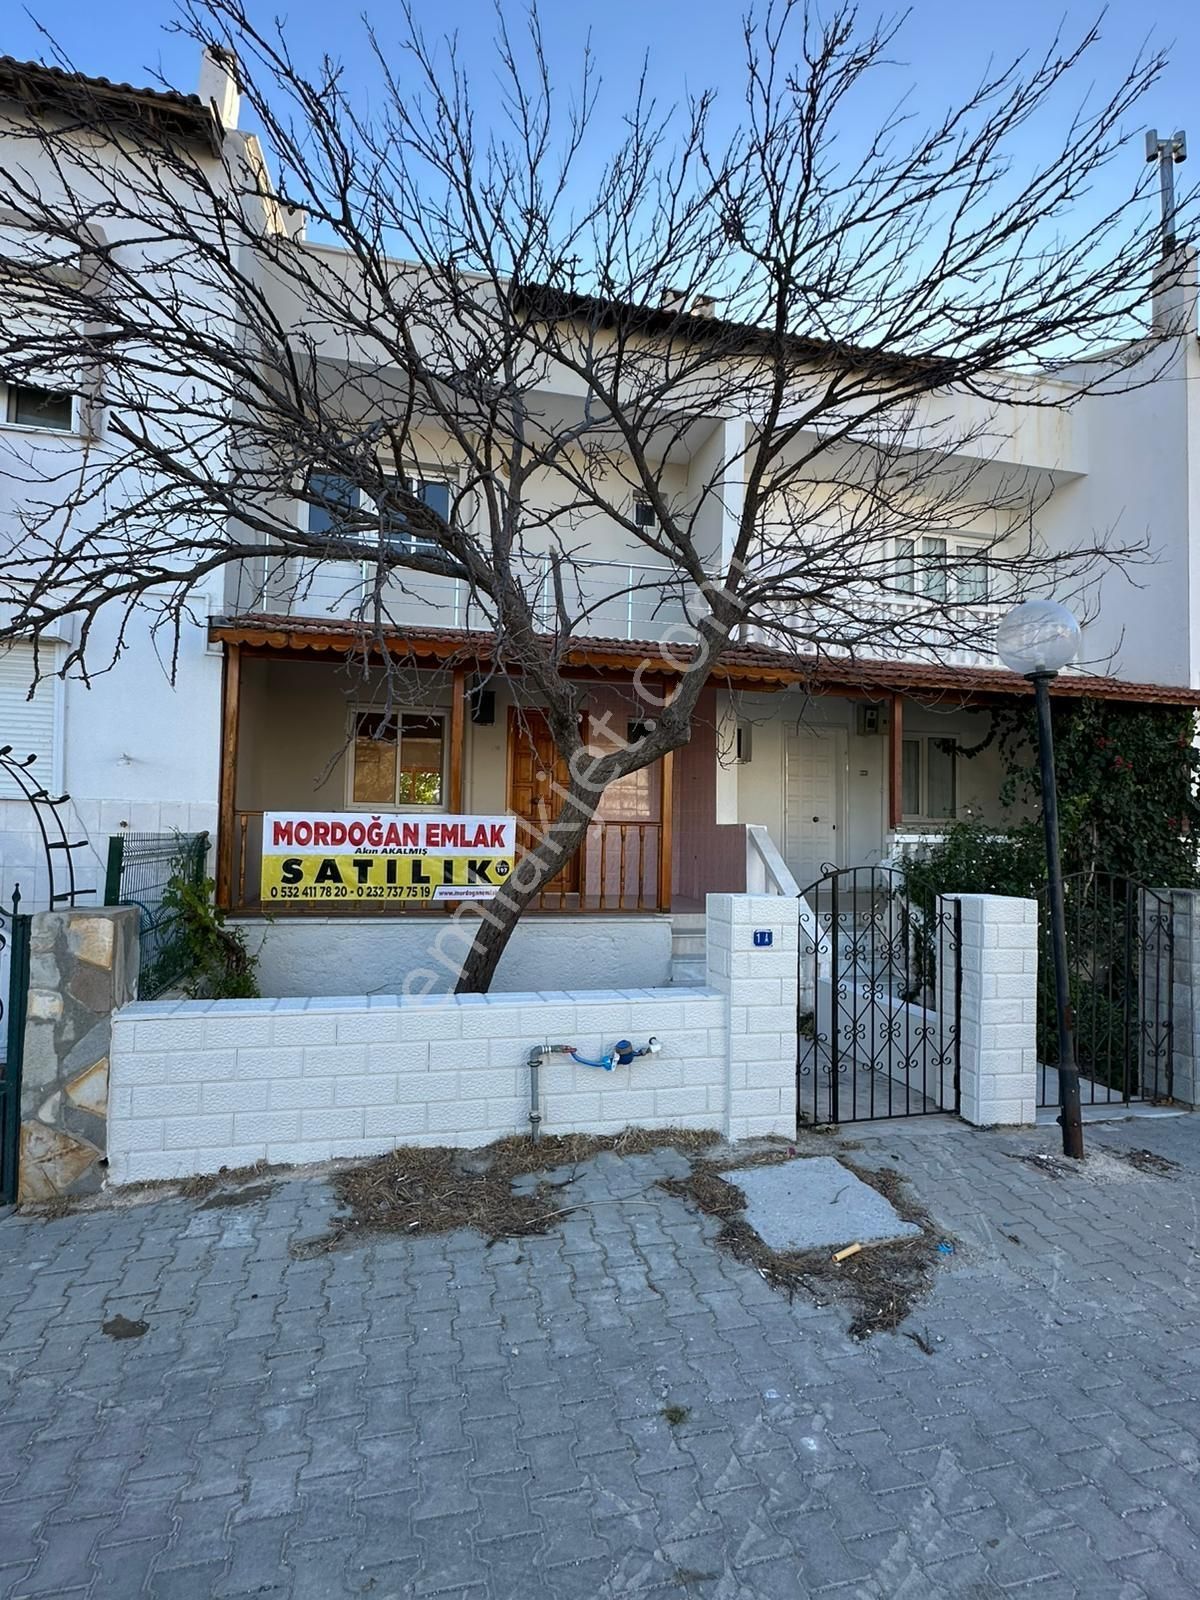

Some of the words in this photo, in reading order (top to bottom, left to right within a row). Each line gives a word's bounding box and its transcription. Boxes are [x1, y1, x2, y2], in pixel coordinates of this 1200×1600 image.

[273, 816, 419, 847] MORDOĞAN
[426, 823, 506, 848] EMLAK
[380, 848, 428, 856] AKALMIŞ
[281, 858, 492, 884] SATILIK
[270, 886, 278, 897] 0
[281, 886, 300, 897] 532
[302, 886, 317, 897] 411
[320, 886, 332, 897] 78
[334, 886, 347, 897] 20
[357, 886, 364, 897] 0
[366, 886, 384, 897] 232
[387, 886, 404, 897] 737
[406, 886, 418, 897] 75
[420, 886, 431, 897] 19
